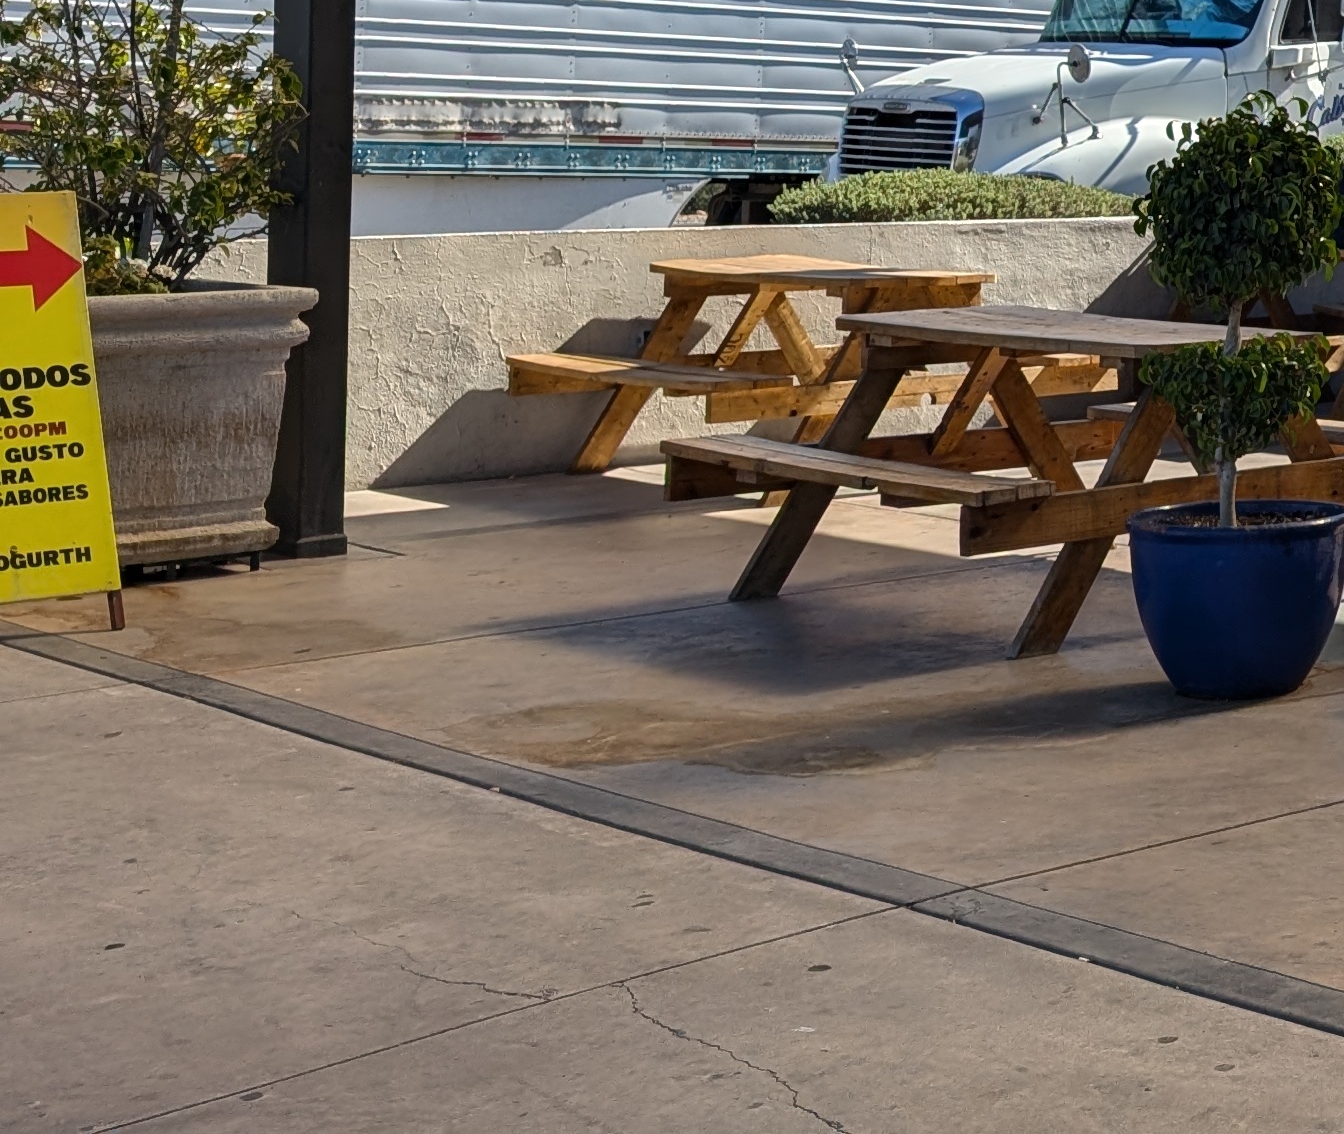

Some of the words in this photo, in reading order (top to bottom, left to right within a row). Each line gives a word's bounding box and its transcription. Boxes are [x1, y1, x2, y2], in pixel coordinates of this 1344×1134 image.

[0, 363, 91, 391] ODOS
[0, 395, 34, 419] AS
[0, 421, 67, 440] :00PM
[5, 442, 84, 463] GUSTO
[0, 468, 34, 485] RA
[0, 547, 91, 571] OGURTH
